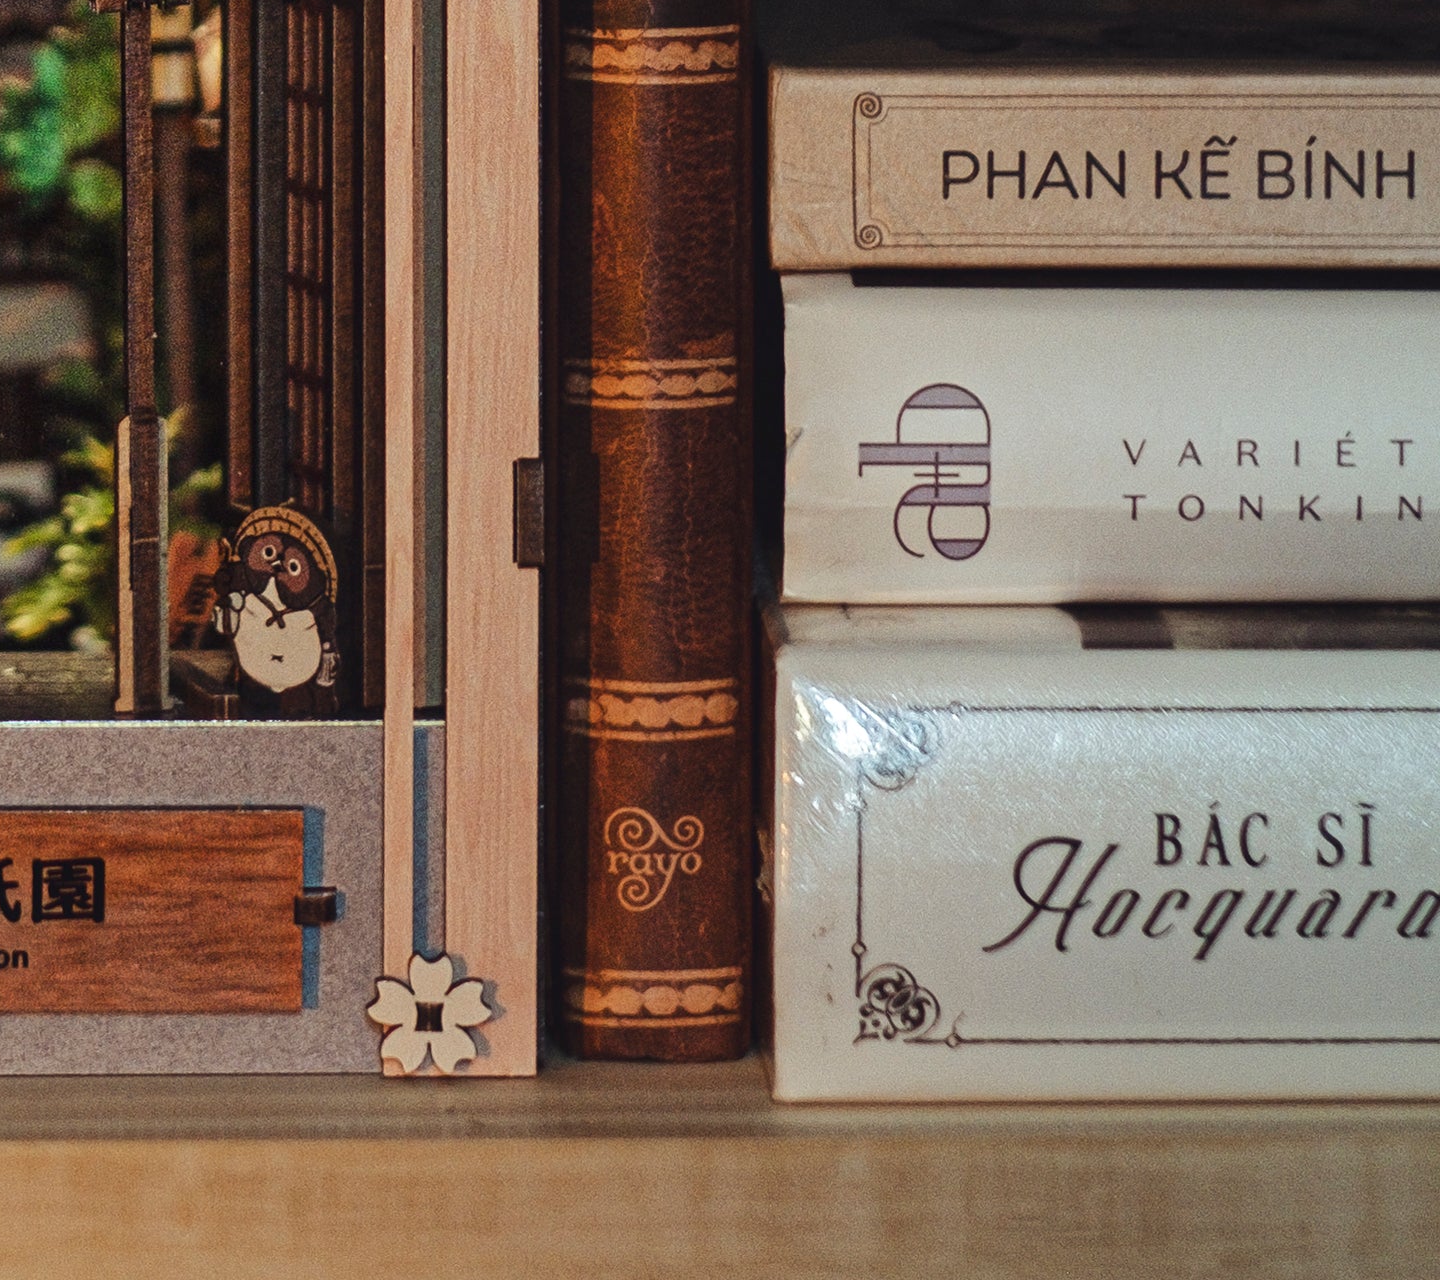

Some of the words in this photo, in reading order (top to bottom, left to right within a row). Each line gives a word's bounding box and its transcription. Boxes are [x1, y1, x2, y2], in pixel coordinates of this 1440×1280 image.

[942, 149, 1127, 200] PHAN
[1257, 137, 1416, 200] BÍNH
[1154, 802, 1268, 868] BÁC
[1317, 804, 1375, 867] SĨ
